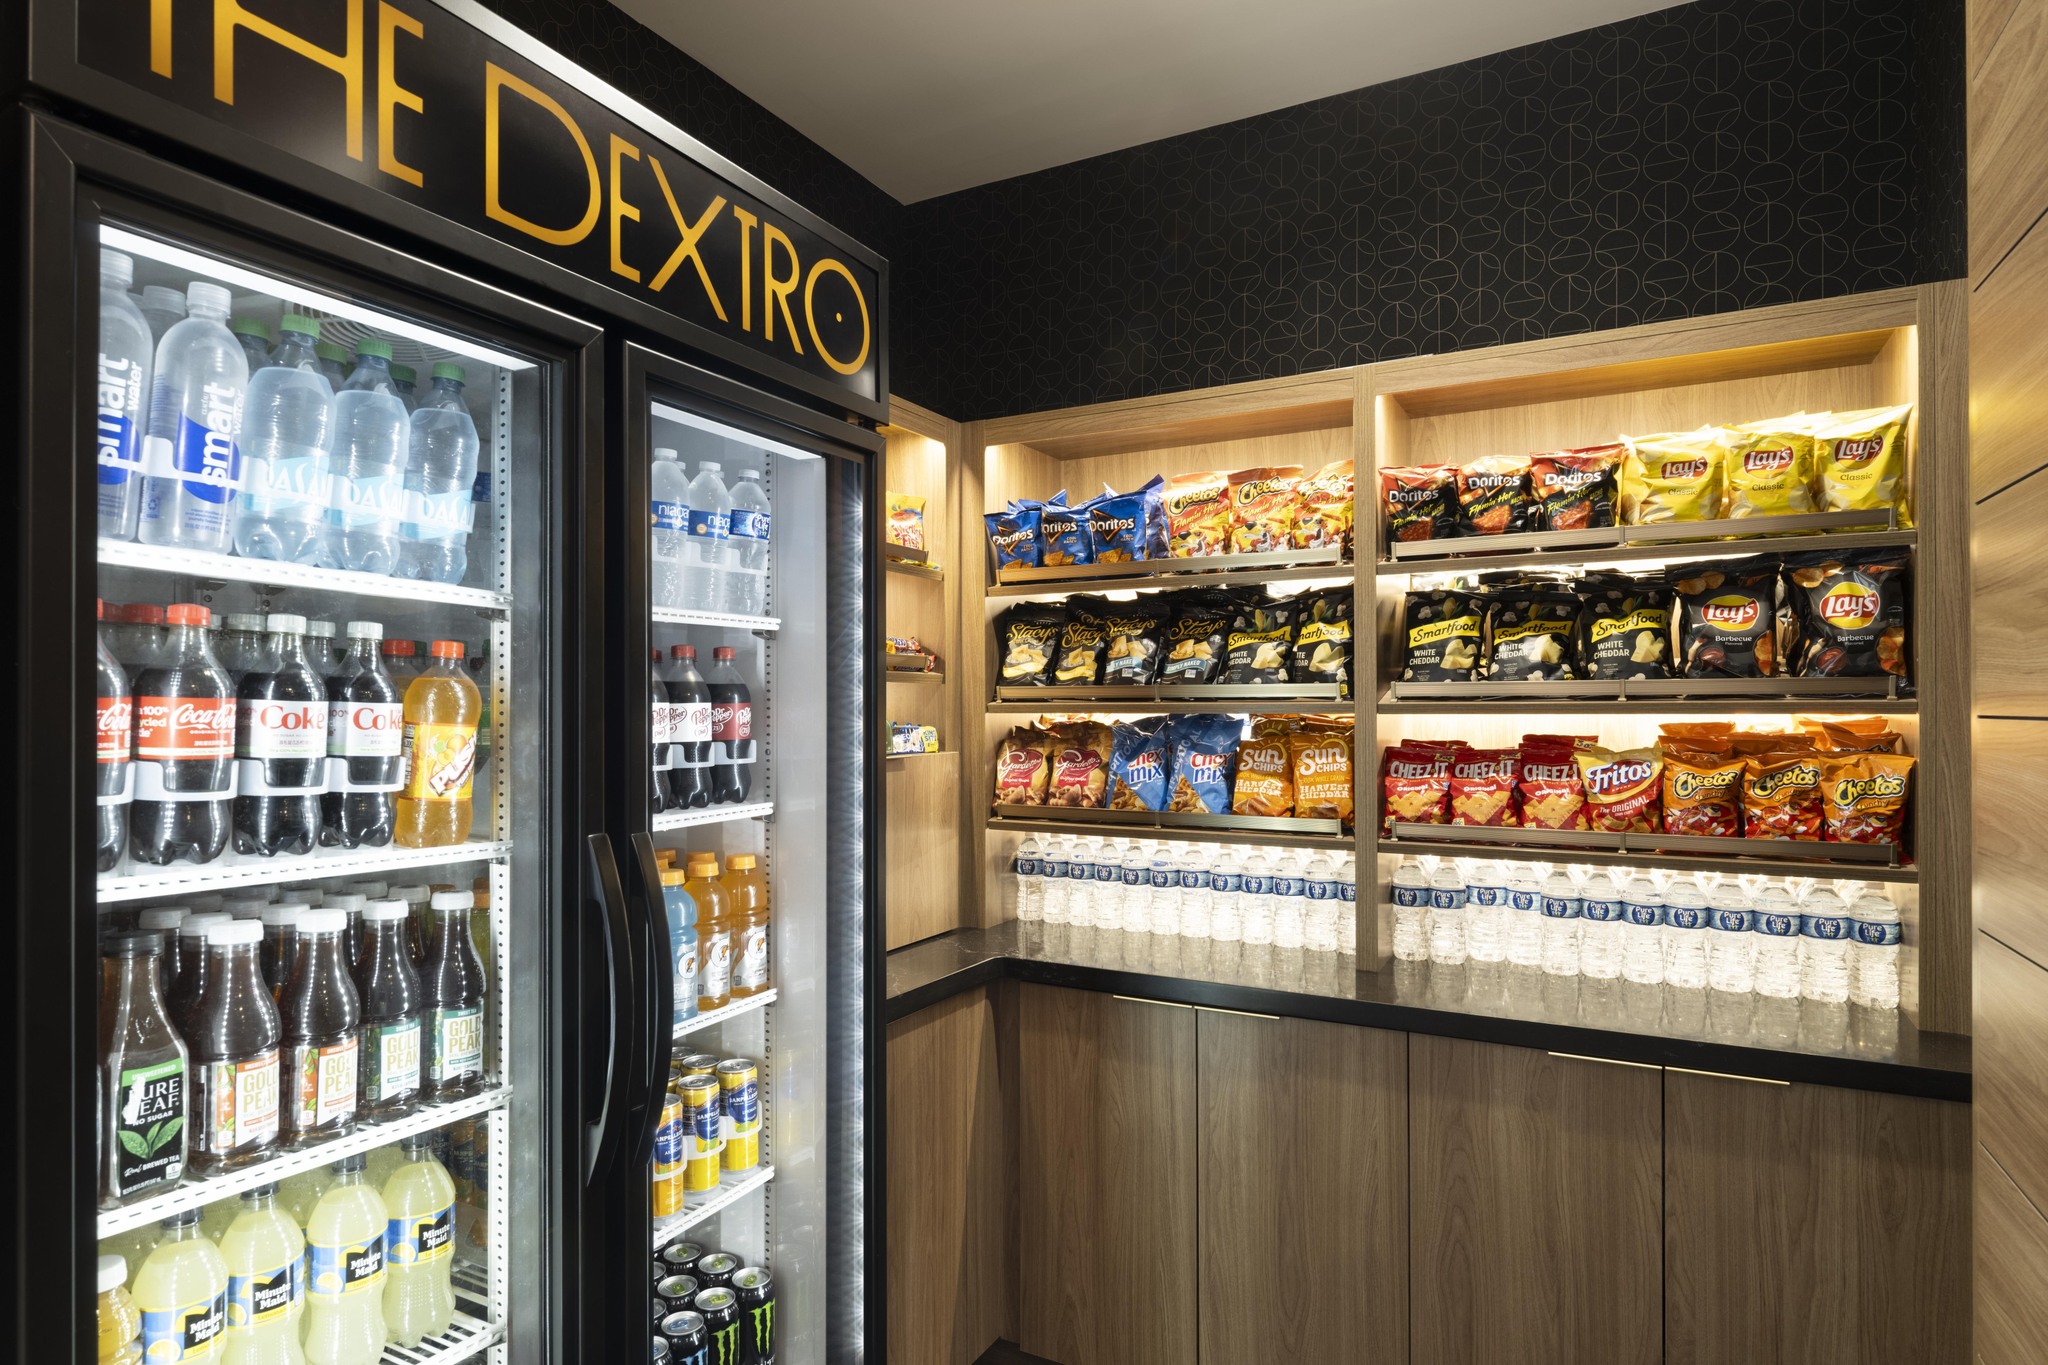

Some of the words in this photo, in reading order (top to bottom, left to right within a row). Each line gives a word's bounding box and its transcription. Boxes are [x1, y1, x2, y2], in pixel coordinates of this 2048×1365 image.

[485, 60, 870, 376] DEXTRO
[126, 361, 143, 411] water
[200, 382, 236, 488] smart
[1837, 436, 1883, 460] Lay's
[1747, 447, 1794, 471] Lay's
[1664, 458, 1706, 479] Lay's
[1840, 472, 1873, 481] Classic
[1469, 475, 1521, 491] Doritos
[1545, 472, 1602, 486] Doritos
[1751, 482, 1785, 491] Classic
[1238, 476, 1293, 505] Cheetos
[1389, 489, 1439, 503] Doritos
[1668, 488, 1698, 496] Classic
[1169, 486, 1220, 515] Cheetos
[1090, 517, 1135, 532] Doritos
[992, 529, 1034, 545] Doritos
[1706, 602, 1756, 624] Lay's
[1825, 593, 1876, 617] Lay's
[1105, 618, 1157, 641] Stacy's
[1169, 618, 1226, 640] Stacy's
[1413, 620, 1477, 642] Smartfood
[1498, 623, 1568, 640] Smartfood
[1596, 613, 1662, 636] Smartfood
[1006, 623, 1058, 646] Stacy's
[1229, 631, 1286, 647] Smartfood
[1837, 634, 1874, 642] Barbecue
[1413, 649, 1436, 657] WHITE
[1498, 643, 1524, 652] WHITE
[1597, 640, 1624, 651] WHITE
[1409, 656, 1440, 666] CHEDDAR
[1494, 649, 1528, 661] CHEDDAR
[1593, 649, 1630, 660] CHEDDAR
[260, 695, 325, 730] Coke
[1239, 744, 1286, 771] Sun
[1299, 744, 1349, 776] Sun
[1128, 764, 1165, 784] mix
[1193, 765, 1227, 785] mix
[1253, 762, 1283, 773] CHIPS
[1315, 763, 1347, 773] CHIPS
[1235, 779, 1284, 789] HARVEST
[1586, 761, 1652, 794] Fritos
[1674, 770, 1739, 799] Cheetos
[1751, 765, 1821, 798] Cheetos
[1234, 786, 1282, 797] CHEDDAR
[1300, 784, 1350, 793] HARVEST
[1300, 790, 1350, 800] CHEDDAR
[1693, 788, 1726, 802] Crunchy
[1834, 775, 1905, 807] Cheetos
[1611, 795, 1650, 813] ORIGINAL
[1854, 798, 1889, 811] Crunchy
[1590, 901, 1606, 909] Pure
[1635, 906, 1652, 914] Pure
[1677, 909, 1695, 917] Pure
[1723, 911, 1742, 919] Pure
[1769, 915, 1789, 923] Pure
[1818, 918, 1838, 926] Pure
[1862, 923, 1883, 931] Pure
[449, 1016, 480, 1037] GOLD
[387, 1031, 419, 1055] GOLD
[448, 1034, 480, 1054] PEAK
[386, 1048, 418, 1072] PEAK
[131, 1077, 180, 1102] URE
[147, 1110, 174, 1122] SUGAR
[142, 1158, 169, 1171] BREWED
[169, 1154, 180, 1164] TEA
[423, 1223, 451, 1240] Minute
[427, 1232, 448, 1248] Maid
[351, 1252, 382, 1270] Minute
[355, 1261, 379, 1278] Maid
[254, 1282, 292, 1301] Minute
[259, 1293, 287, 1310] Maid
[190, 1312, 224, 1335] Minute
[194, 1322, 220, 1343] Maid
